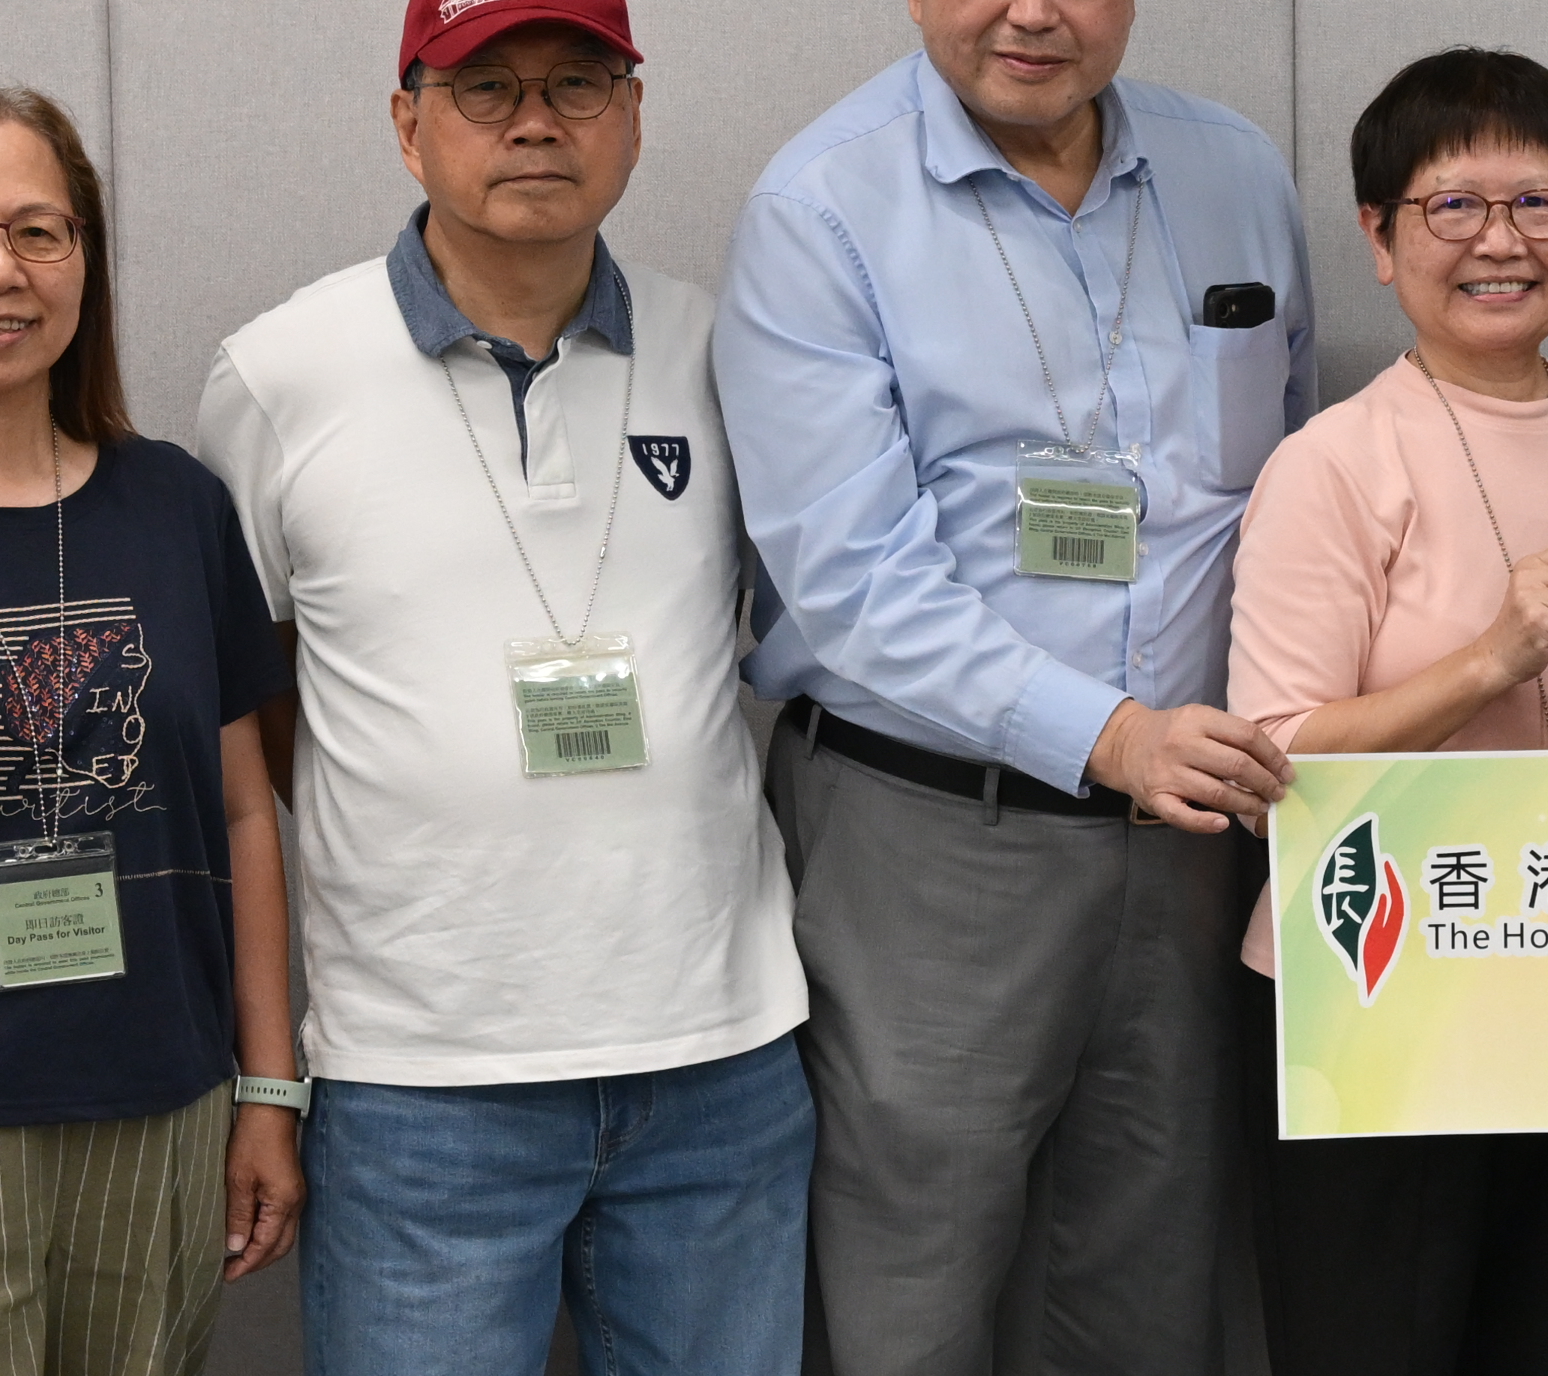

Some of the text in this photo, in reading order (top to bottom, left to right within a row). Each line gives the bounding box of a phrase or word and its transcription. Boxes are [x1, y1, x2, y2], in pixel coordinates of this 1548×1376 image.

[642, 443, 679, 456] 1977
[94, 882, 103, 898] 3
[7, 926, 105, 945] Day Pass for Visitor
[1427, 922, 1490, 950] The
